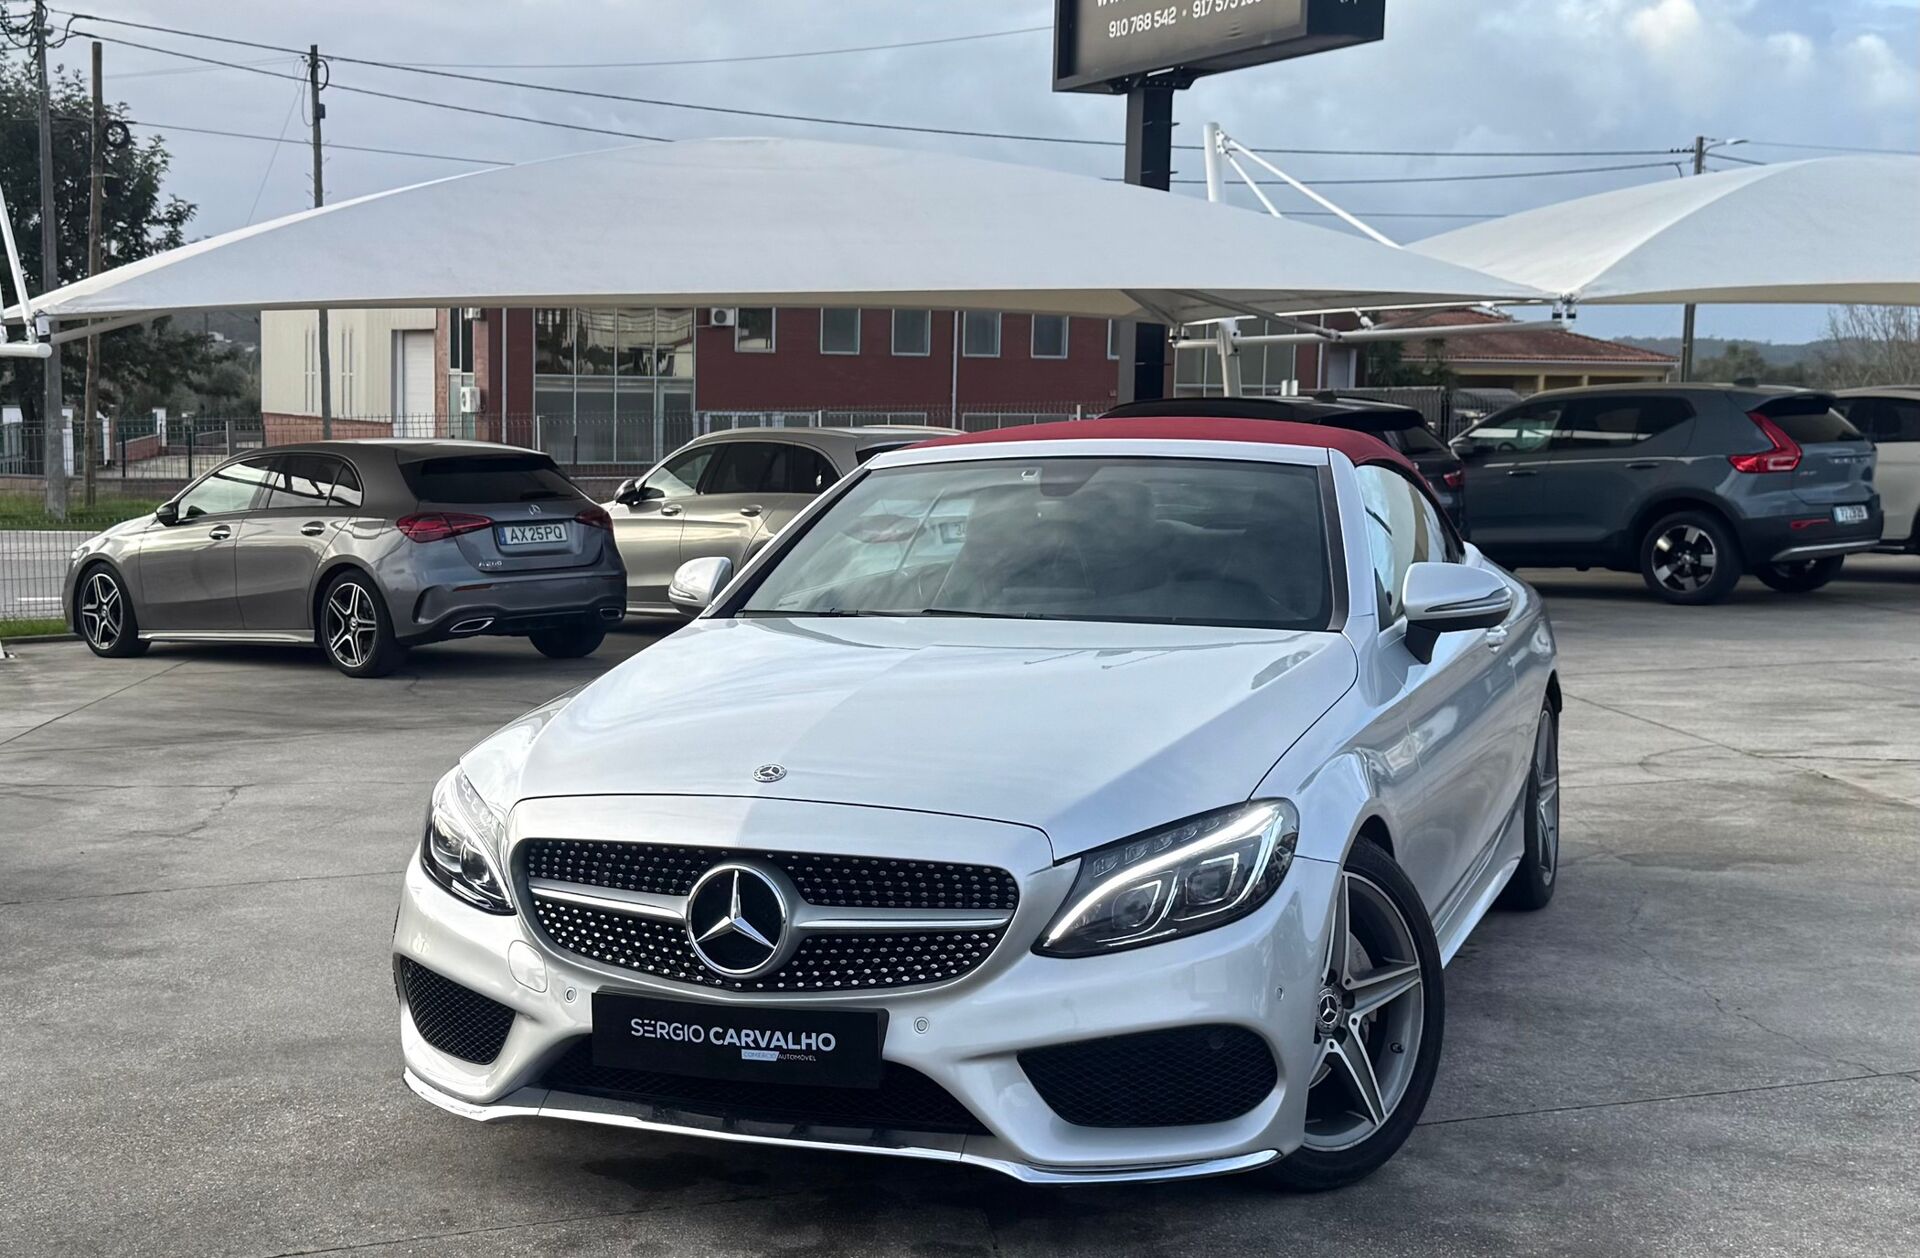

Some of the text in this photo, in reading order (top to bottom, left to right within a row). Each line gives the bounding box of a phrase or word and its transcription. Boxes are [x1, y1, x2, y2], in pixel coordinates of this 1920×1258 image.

[1108, 18, 1129, 38] 910
[1130, 12, 1152, 35] 768
[1153, 6, 1177, 28] 542
[709, 1027, 836, 1051] CARVALHO
